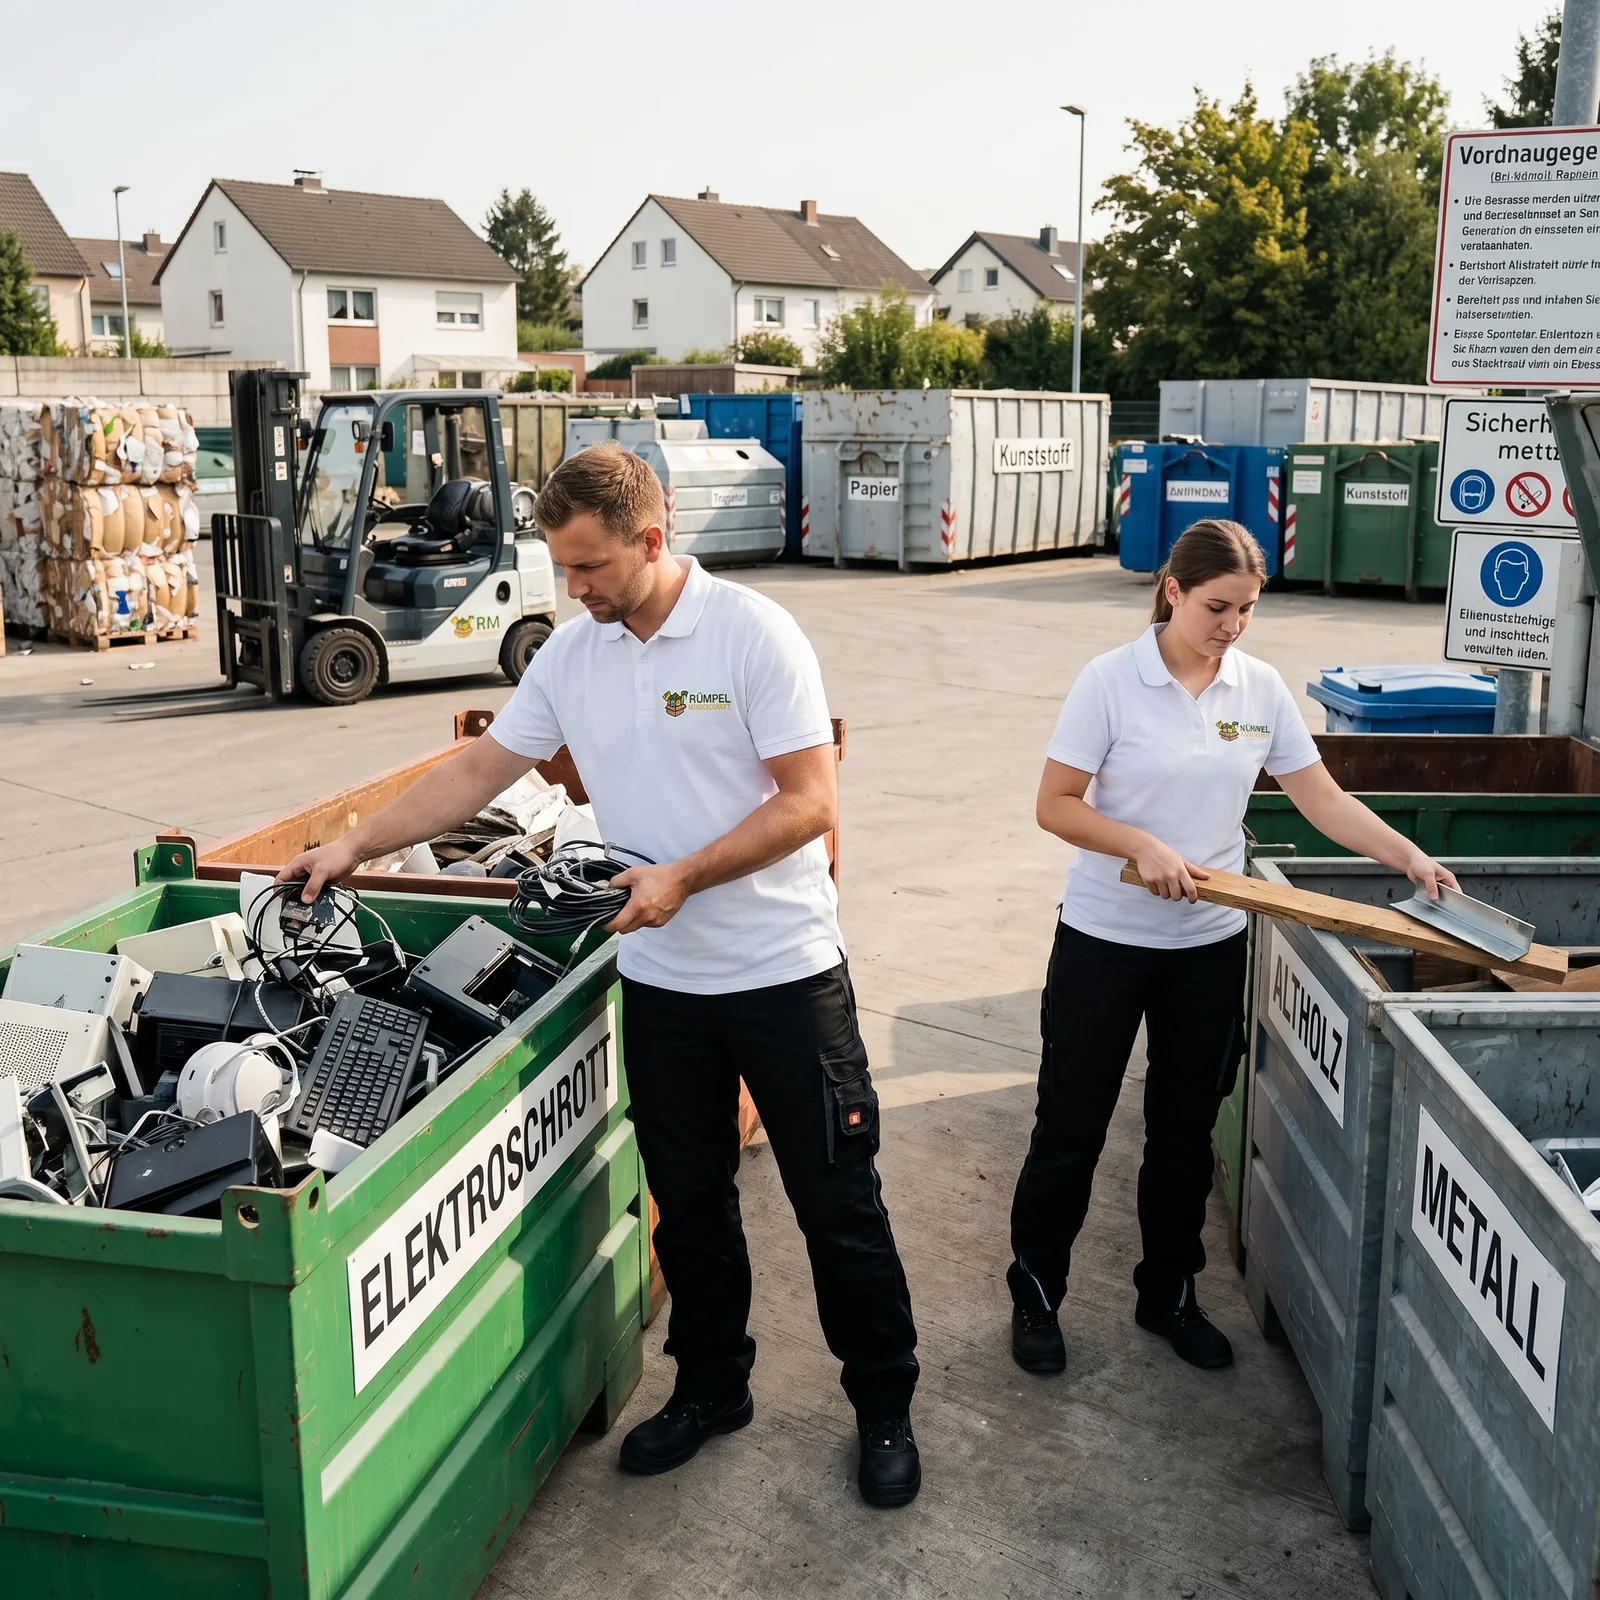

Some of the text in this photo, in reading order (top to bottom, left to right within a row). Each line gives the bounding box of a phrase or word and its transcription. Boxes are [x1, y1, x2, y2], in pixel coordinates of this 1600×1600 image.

[1460, 144, 1598, 166] Vordnaugege
[1532, 194, 1570, 203] merden
[1463, 211, 1482, 220] und
[1564, 210, 1576, 218] an
[1462, 226, 1516, 235] Generation
[1459, 276, 1475, 285] der
[1531, 345, 1550, 354] den
[1554, 345, 1576, 354] dem
[1578, 345, 1593, 354] ein
[1466, 412, 1552, 433] Sicherh
[1000, 443, 1071, 467] Kunststoff
[851, 481, 898, 498] Papier
[1346, 488, 1408, 500] Kunststoff
[476, 616, 500, 630] RM
[1465, 627, 1485, 637] und
[689, 692, 731, 703] RÜMPEL
[1272, 955, 1342, 1094] ALTHOLZ
[361, 1031, 611, 1350] ELEKTROSCHROTT
[1420, 1144, 1546, 1382] METALL
